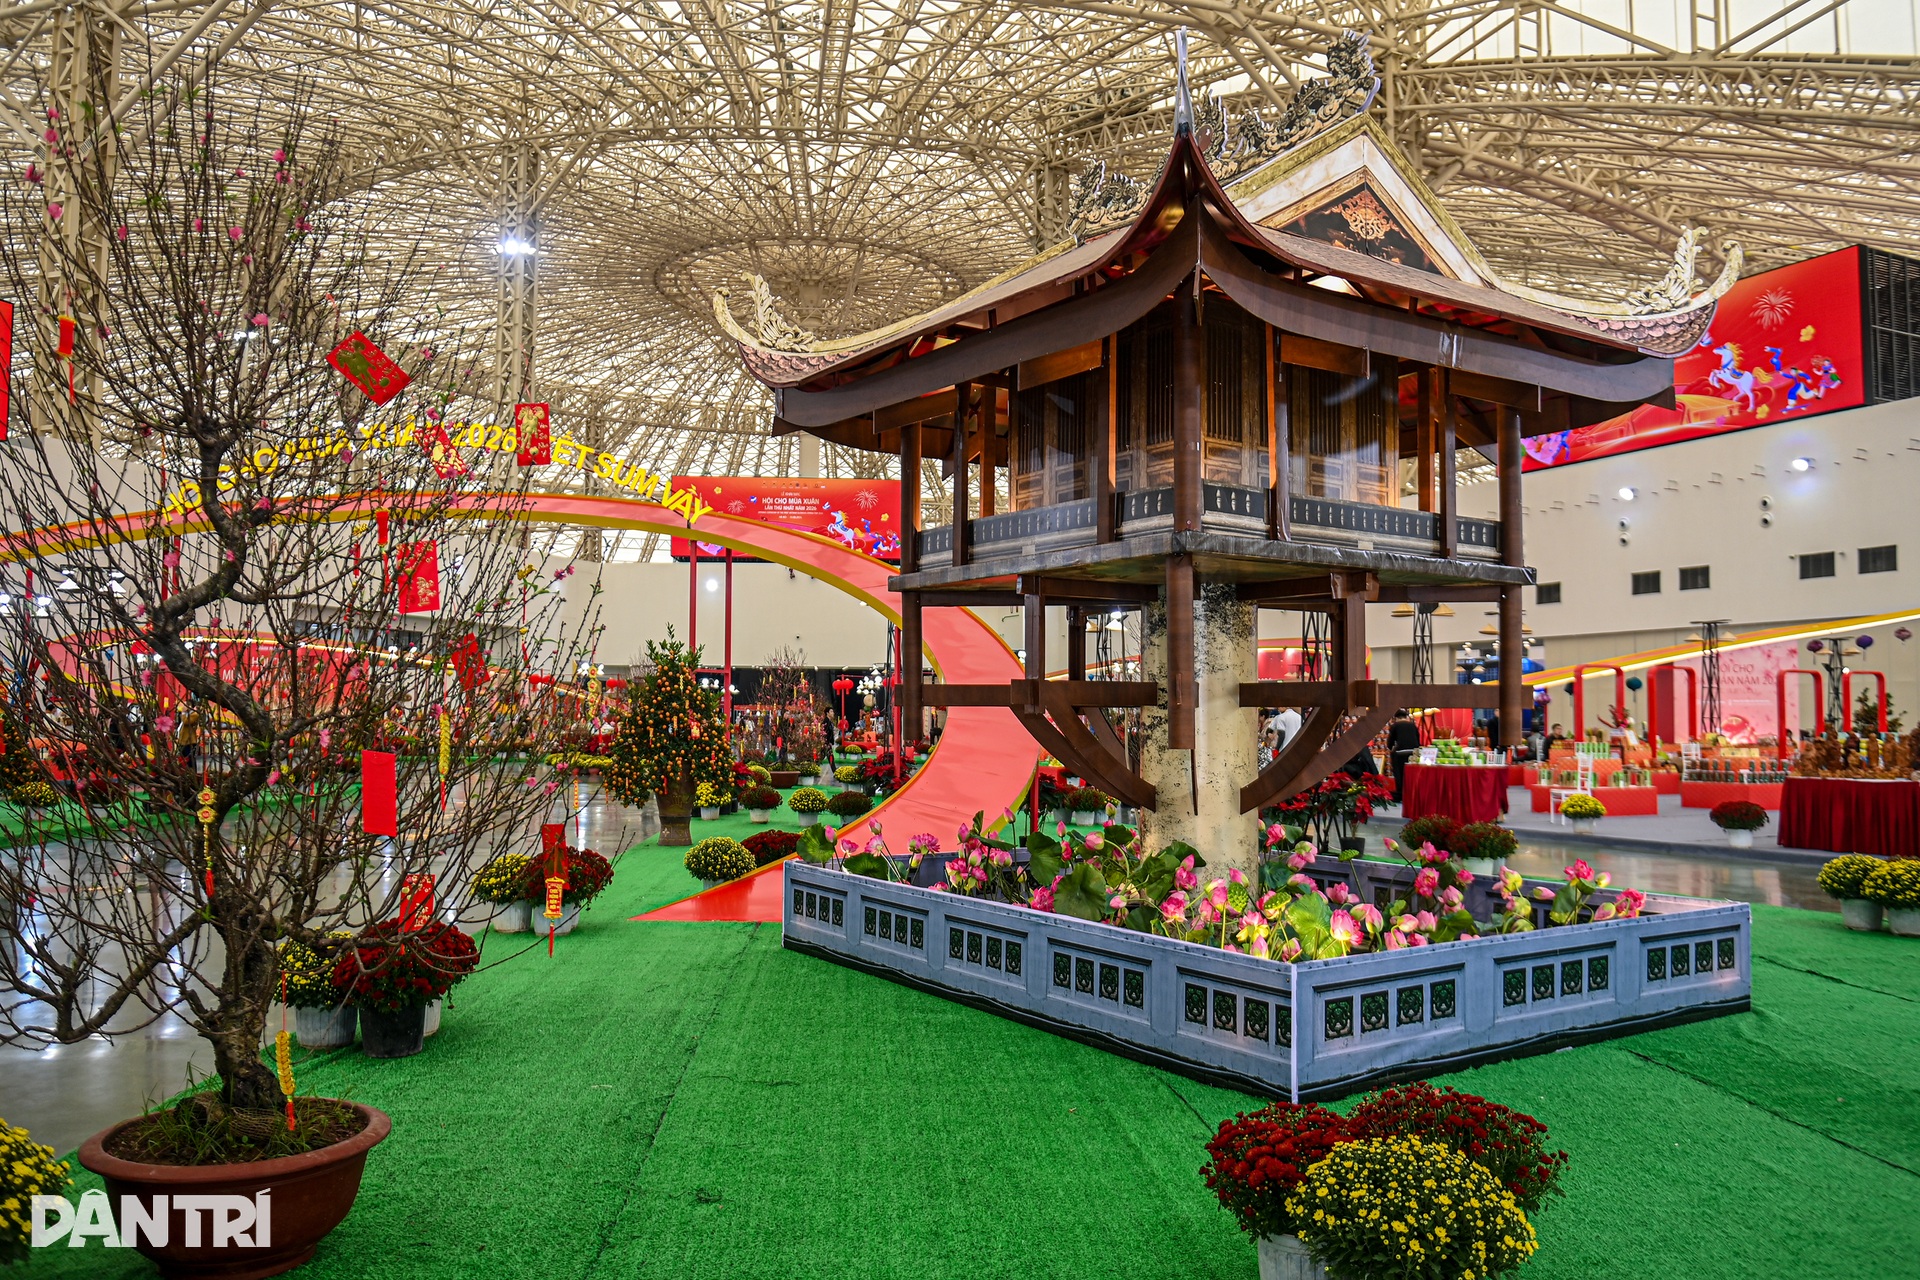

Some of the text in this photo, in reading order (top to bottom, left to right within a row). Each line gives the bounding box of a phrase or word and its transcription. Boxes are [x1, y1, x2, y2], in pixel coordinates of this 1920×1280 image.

[452, 421, 518, 453] 2026
[549, 430, 595, 470] ẾT
[593, 452, 660, 499] SUM
[661, 480, 714, 525] VẦY
[774, 497, 788, 505] CHỢ
[788, 497, 802, 505] MÙA
